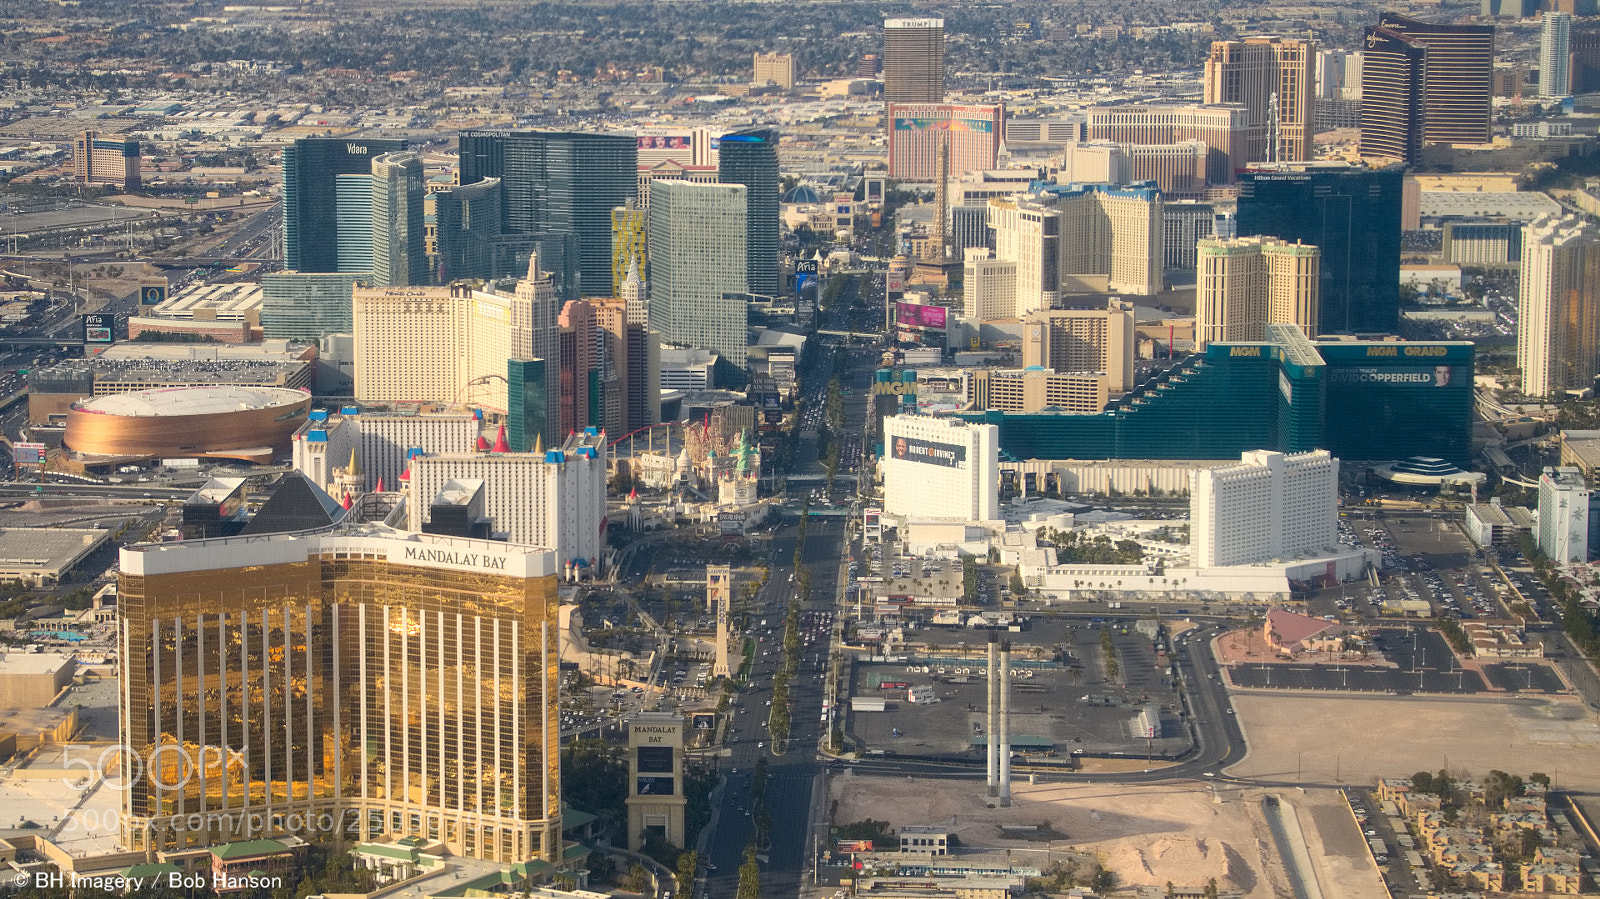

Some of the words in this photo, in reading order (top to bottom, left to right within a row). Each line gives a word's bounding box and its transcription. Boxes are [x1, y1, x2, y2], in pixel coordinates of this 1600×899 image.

[346, 142, 368, 154] Vdara
[797, 262, 816, 272] Aria
[86, 315, 102, 323] Aria
[1230, 346, 1260, 356] MGM
[1366, 346, 1398, 356] MGM
[1404, 346, 1448, 356] GRAND
[876, 382, 918, 395] MGM
[405, 547, 478, 566] MANDALAY
[483, 555, 506, 569] BAY
